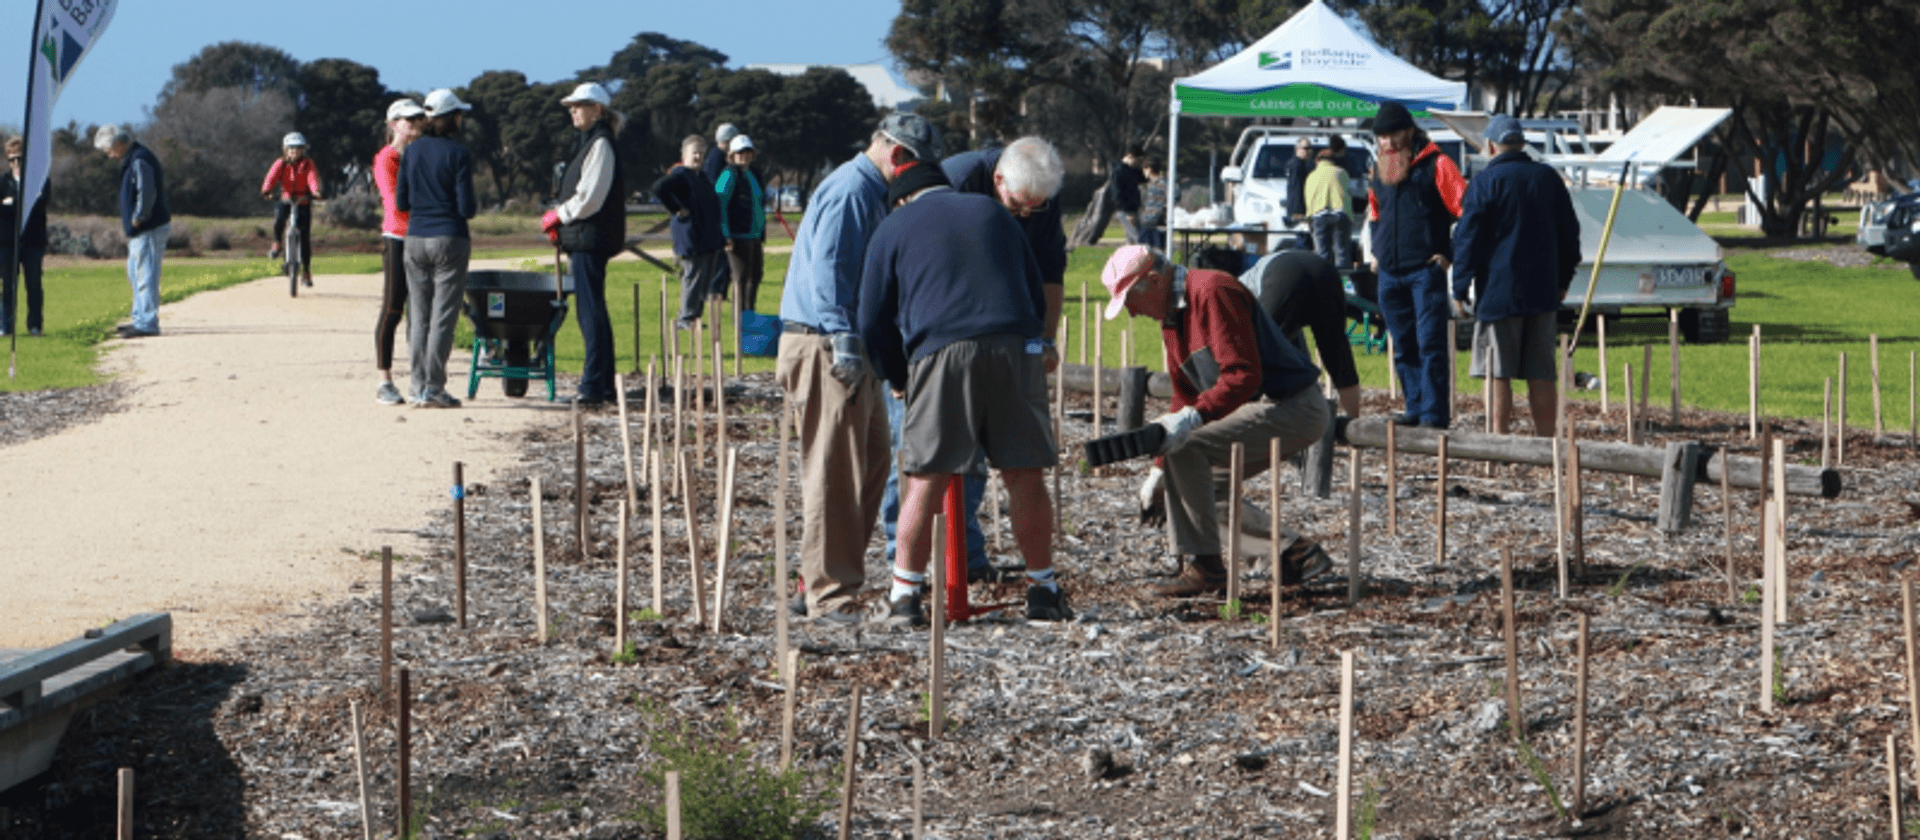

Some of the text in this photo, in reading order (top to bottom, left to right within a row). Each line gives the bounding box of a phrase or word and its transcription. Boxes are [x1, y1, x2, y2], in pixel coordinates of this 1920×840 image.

[1249, 98, 1380, 111] CARING FOR OUR COA
